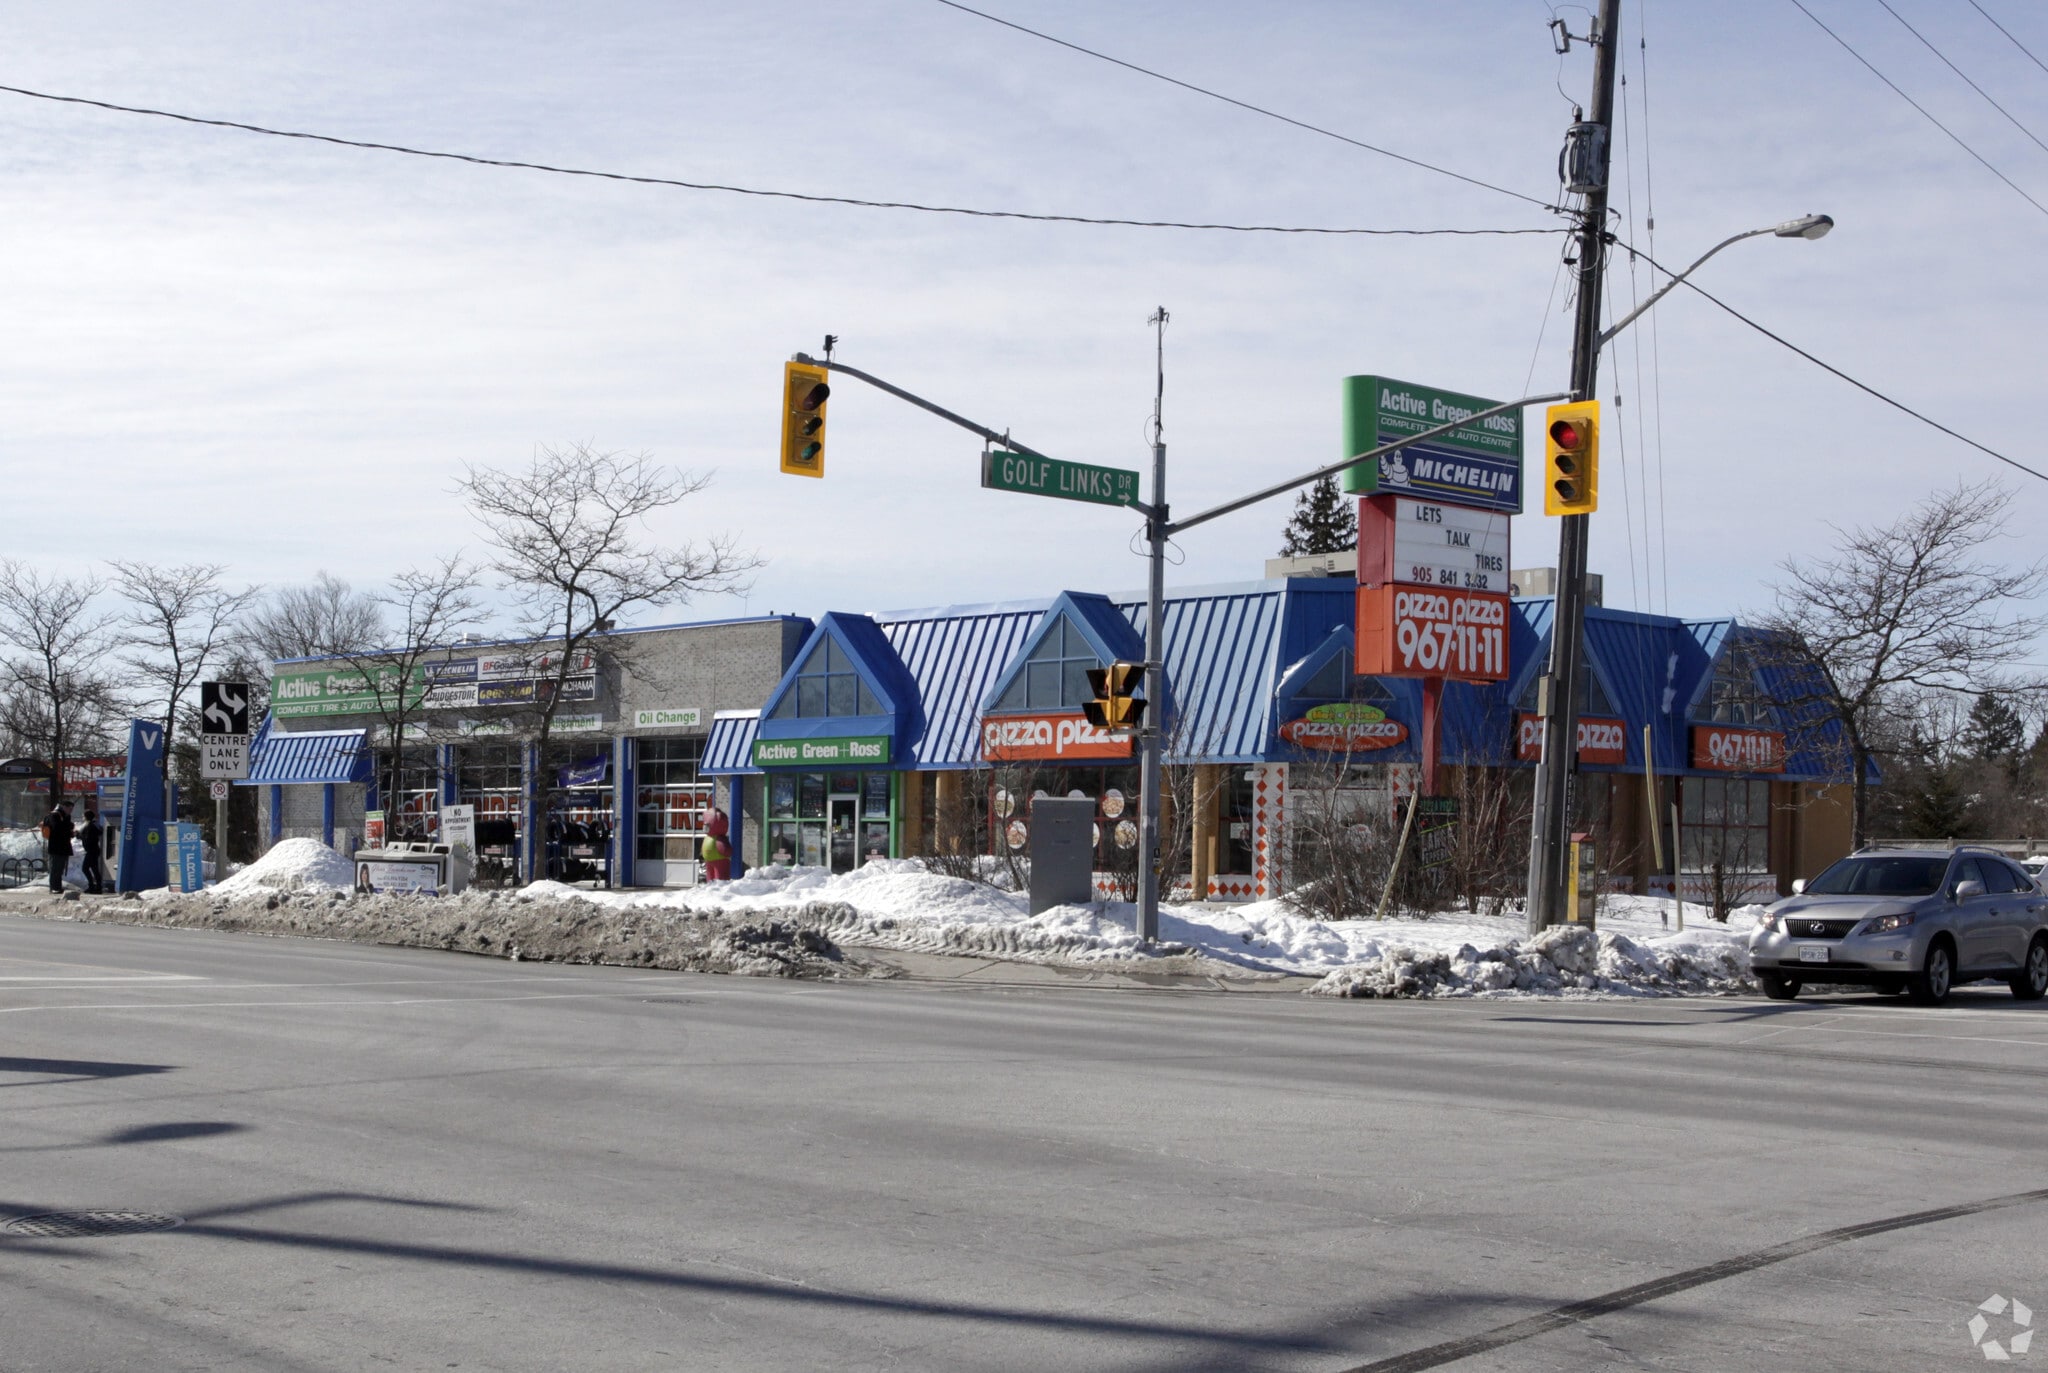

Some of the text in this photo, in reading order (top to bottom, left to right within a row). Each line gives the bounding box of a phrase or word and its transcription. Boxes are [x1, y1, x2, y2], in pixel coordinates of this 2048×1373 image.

[1381, 388, 1426, 416] Active
[1381, 417, 1426, 433] COMPLETE
[1457, 431, 1478, 443] AUTO
[1481, 436, 1512, 449] CENTRE
[1003, 458, 1131, 497] GOLF LINKS DR
[1414, 458, 1513, 492] MICHELIN
[1416, 505, 1442, 523] LETS
[1446, 530, 1470, 547] TALK
[1475, 554, 1502, 571] TIRES
[1412, 566, 1432, 583] 905
[1440, 569, 1457, 585] 841
[1395, 592, 1503, 630] pizza pizza
[277, 677, 320, 699] Active
[277, 703, 319, 714] COMPLETE
[322, 702, 338, 712] TIRE
[351, 701, 374, 710] AUTO
[376, 698, 411, 709] ENTE
[639, 710, 696, 725] Oil Change
[203, 735, 247, 746] CENTRE
[985, 720, 1053, 756] pizza
[1293, 722, 1398, 741] pizza pizza
[1577, 723, 1623, 752] pizza
[210, 748, 240, 758] LANE
[758, 743, 797, 760] Active
[210, 761, 240, 771] ONLY
[125, 776, 138, 841] Golf Links Drive
[453, 808, 462, 816] NO
[181, 832, 198, 840] JOB
[186, 853, 197, 890] FREE
